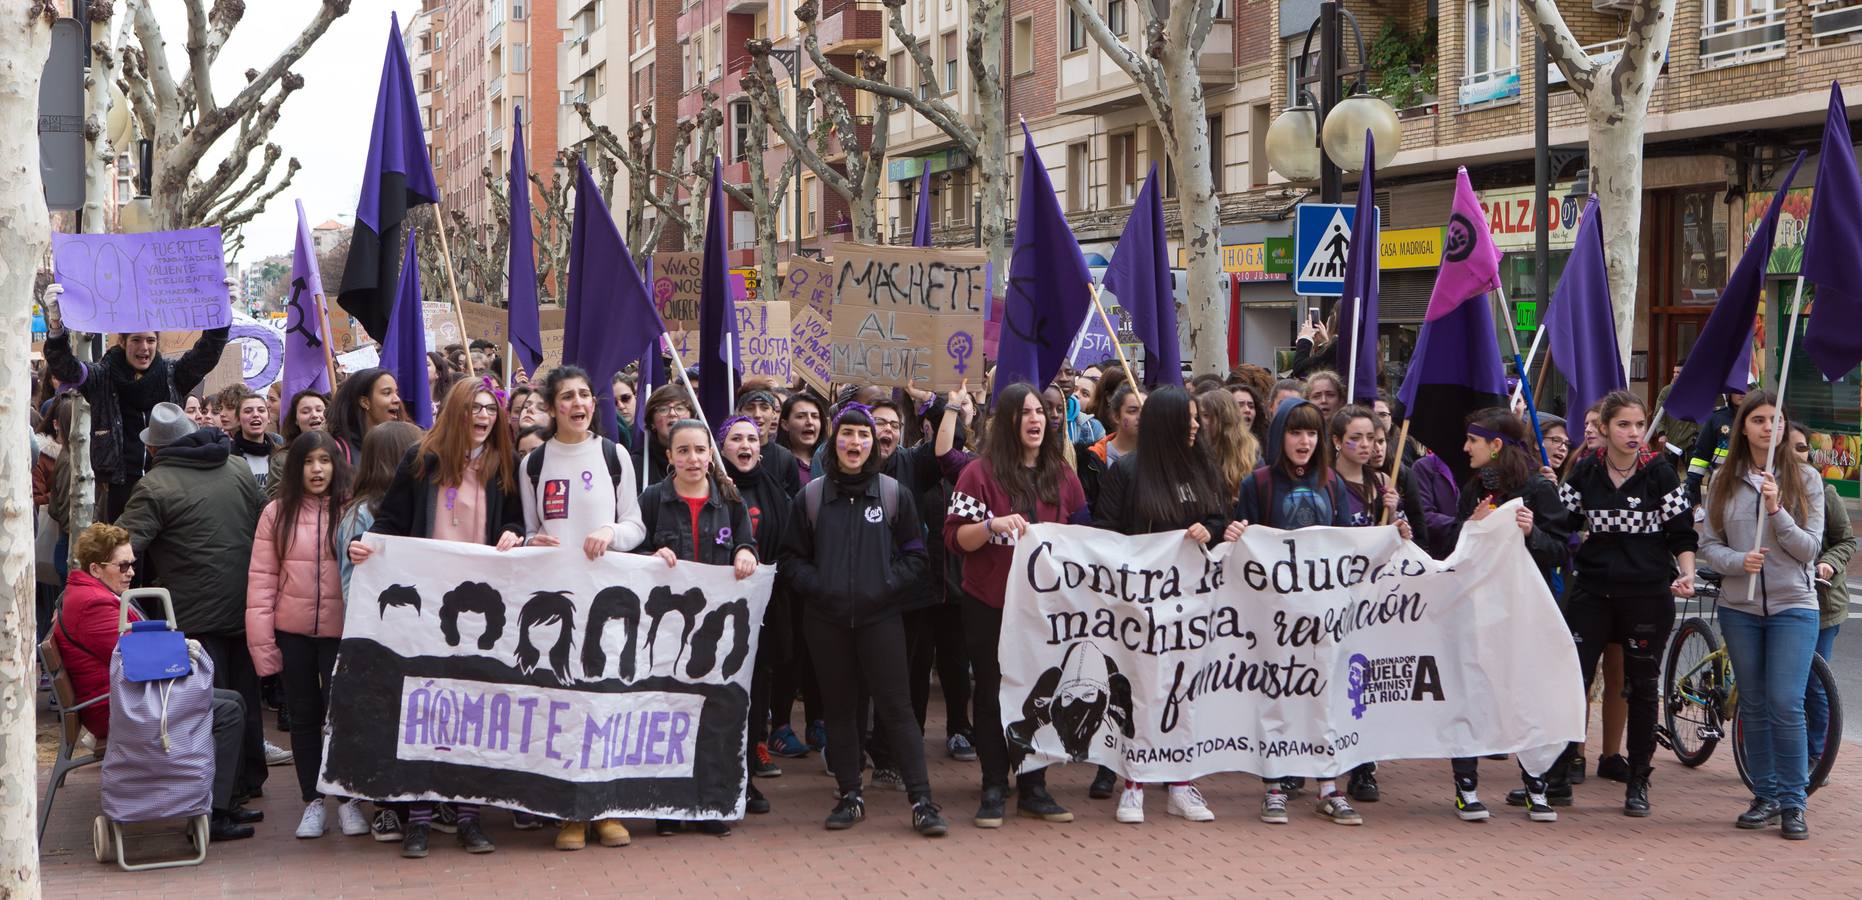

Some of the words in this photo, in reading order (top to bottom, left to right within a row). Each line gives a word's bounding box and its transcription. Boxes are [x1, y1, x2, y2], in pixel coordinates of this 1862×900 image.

[1782, 218, 1805, 246] FR
[152, 239, 209, 256] FUERTE
[1380, 243, 1397, 256] CASA
[1400, 240, 1434, 256] MADRIGAL
[56, 240, 146, 324] SOY
[145, 263, 197, 276] VALIENTE
[674, 279, 703, 295] NOS
[836, 259, 981, 312] MACHETE
[805, 315, 829, 338] VOY
[857, 312, 909, 342] AL
[749, 336, 790, 357] GUSTA
[831, 342, 932, 381] MACHOTE
[1027, 541, 1182, 604] Contra
[1046, 603, 1257, 656] machista,
[1363, 694, 1377, 705] LA
[580, 711, 691, 769] MUJER
[1103, 734, 1118, 749] SI
[1120, 742, 1195, 763] PARAMOS
[1196, 736, 1255, 758] TODAS,
[1259, 740, 1336, 758] PARAMOS
[1334, 731, 1360, 751] TODO
